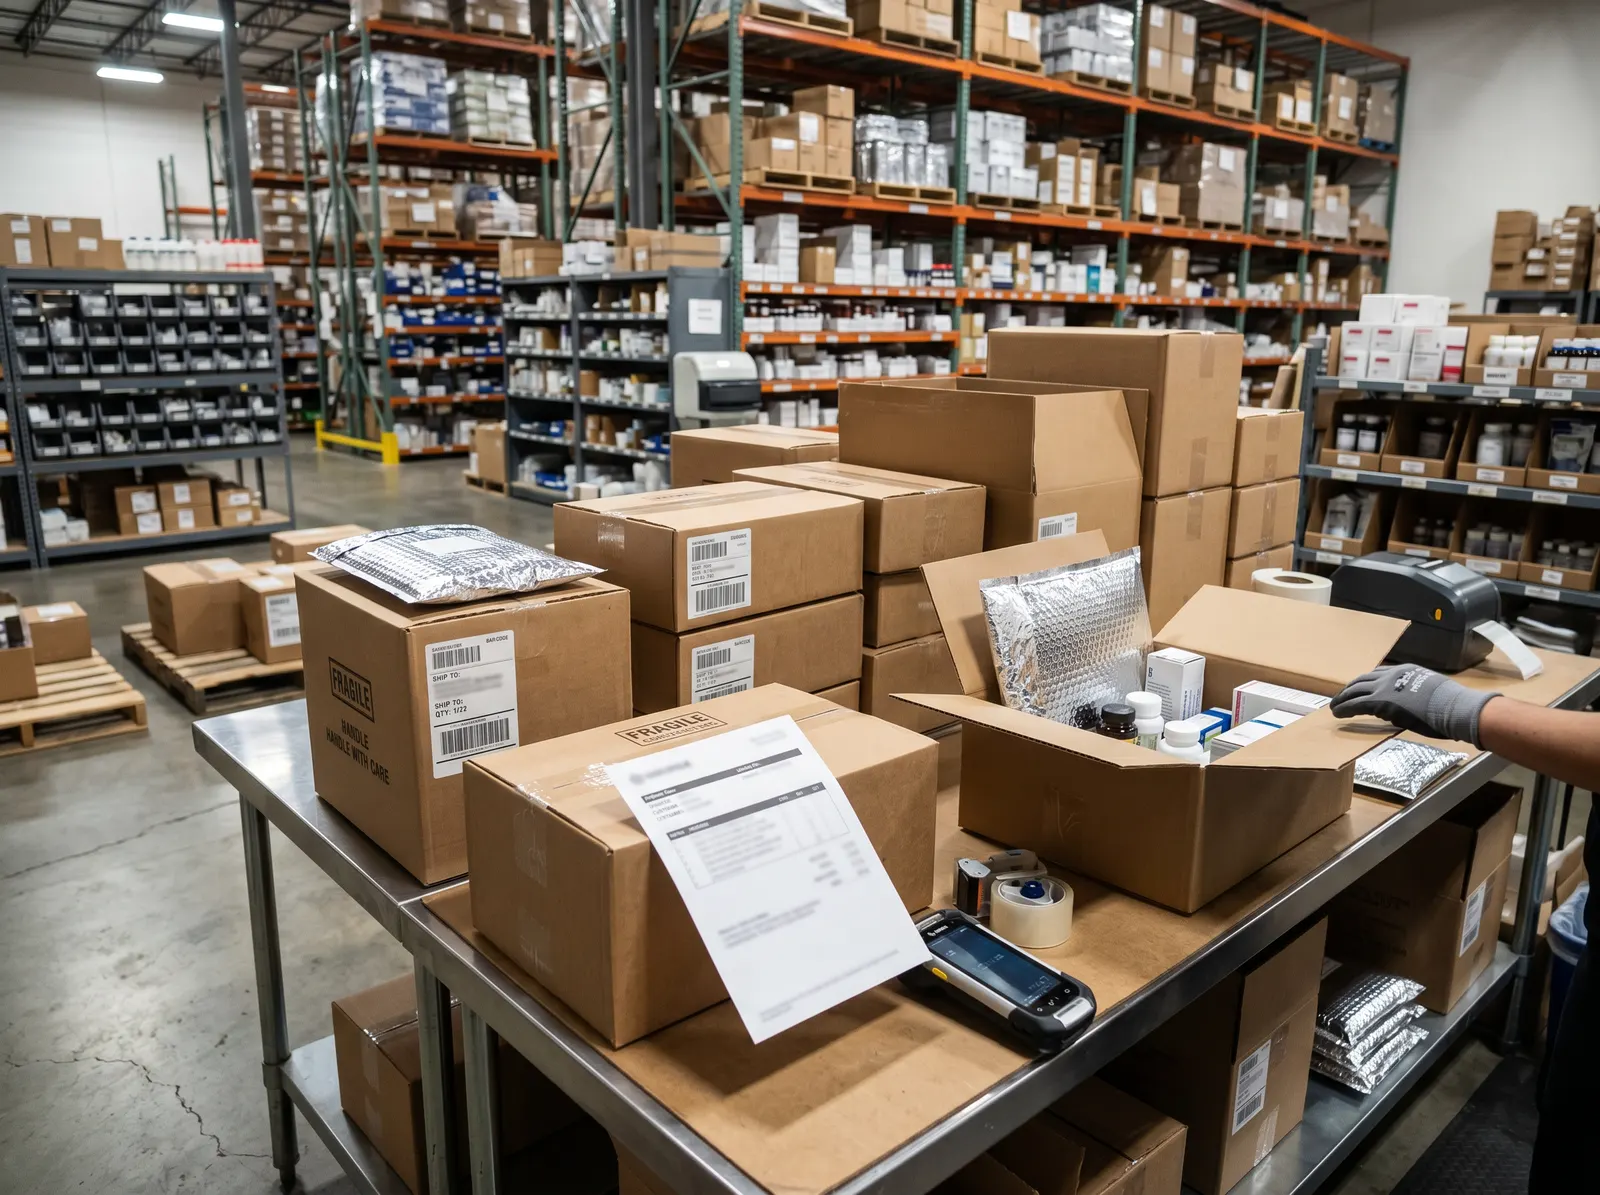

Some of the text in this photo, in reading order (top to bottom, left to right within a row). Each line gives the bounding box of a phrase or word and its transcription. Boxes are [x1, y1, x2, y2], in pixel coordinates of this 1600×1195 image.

[332, 667, 371, 712] FRAGILE
[432, 674, 448, 682] SHIP
[434, 701, 451, 709] SHIP
[435, 705, 467, 718] QTY: 1/22
[341, 718, 369, 750] HANDLE
[625, 714, 709, 740] FRAGILE
[326, 726, 390, 786] HANDLE WITH CARE
